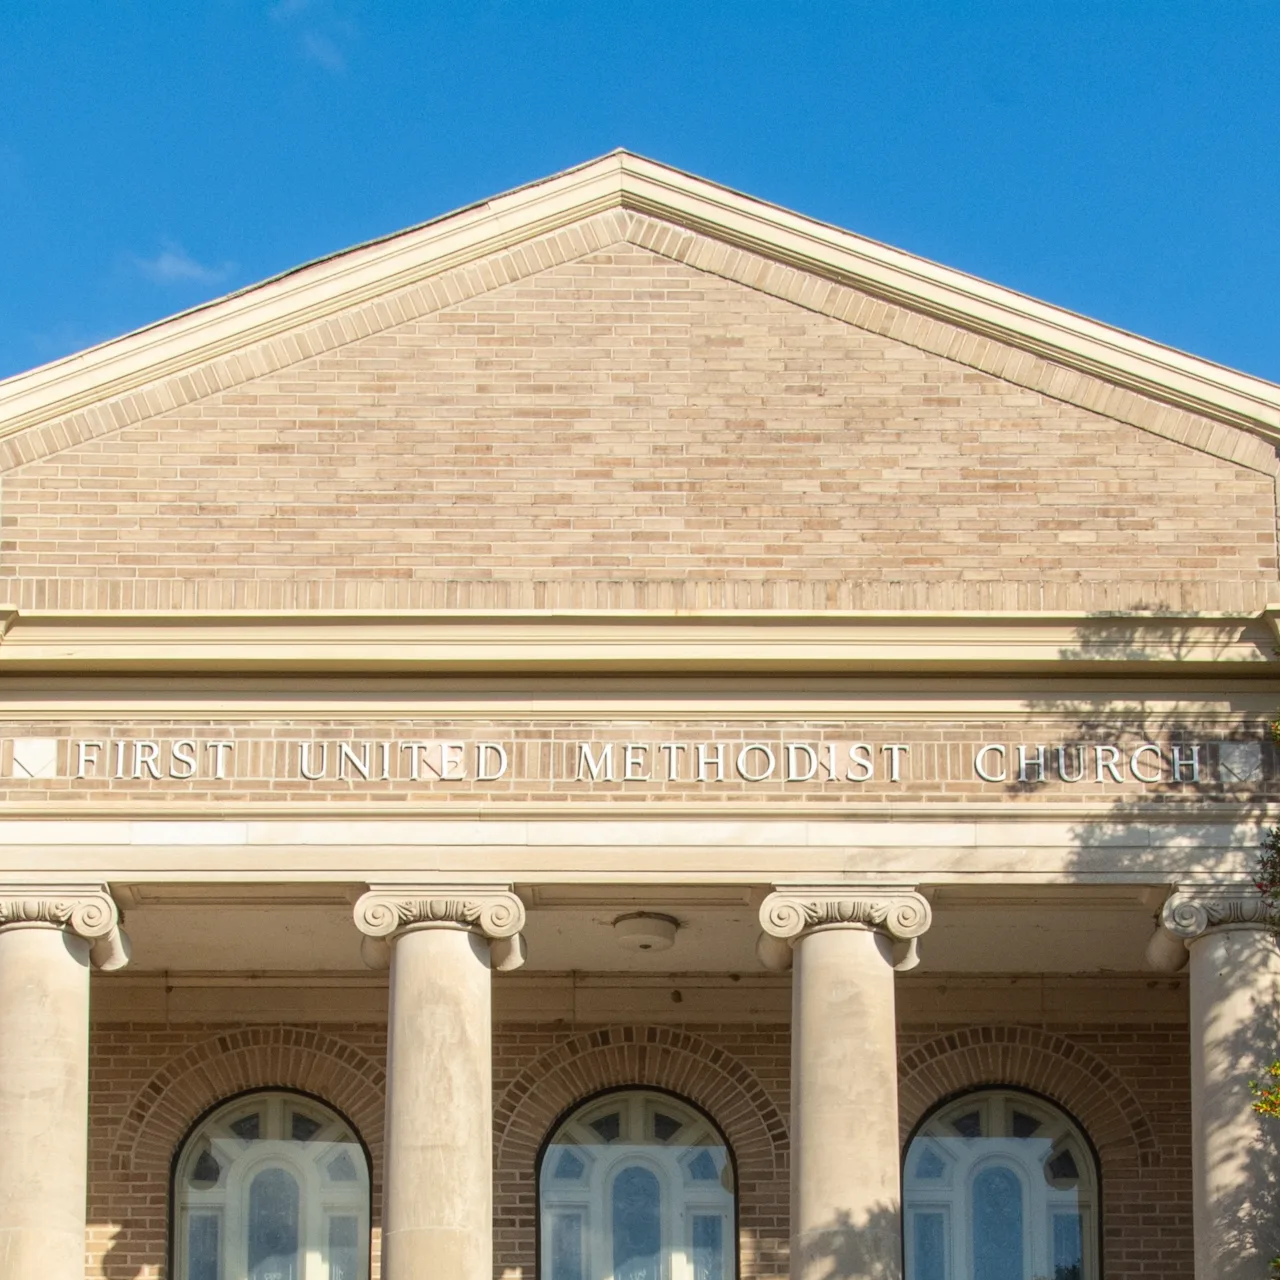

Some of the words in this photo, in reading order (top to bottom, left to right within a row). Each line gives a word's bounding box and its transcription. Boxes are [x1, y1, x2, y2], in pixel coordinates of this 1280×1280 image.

[75, 741, 234, 780] FIRST
[297, 741, 508, 781] UNITED
[574, 742, 908, 783] METHODIST
[975, 743, 1202, 783] CHURCH
